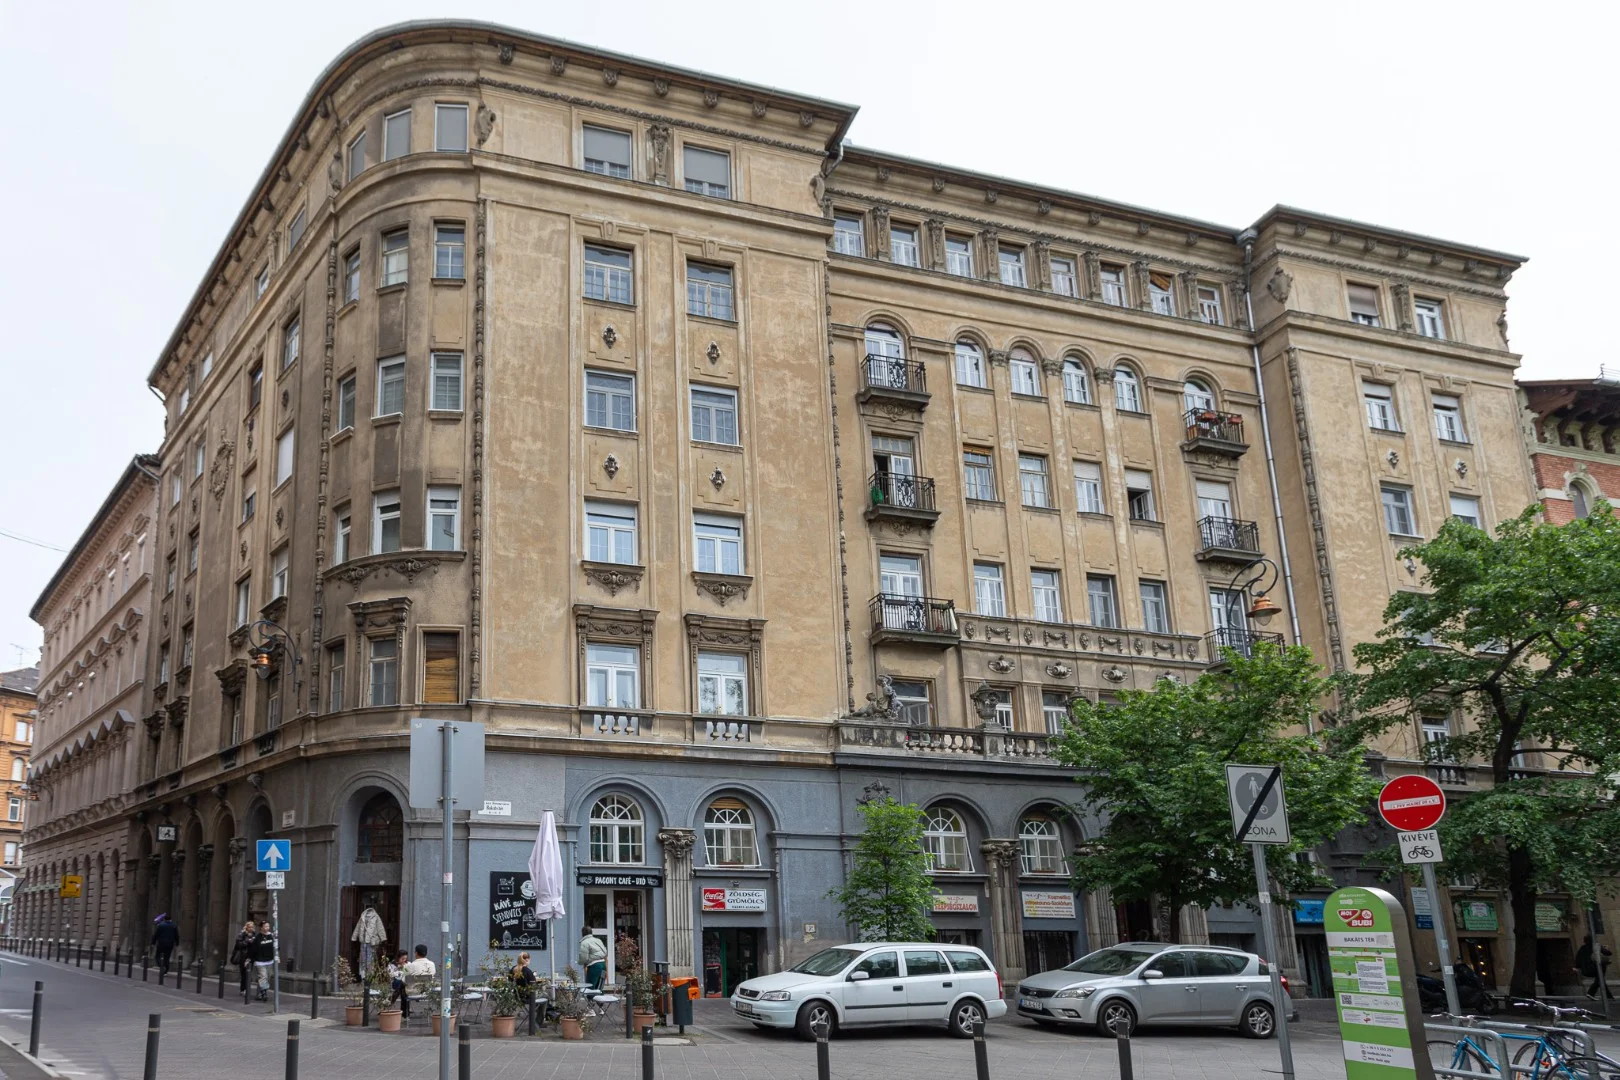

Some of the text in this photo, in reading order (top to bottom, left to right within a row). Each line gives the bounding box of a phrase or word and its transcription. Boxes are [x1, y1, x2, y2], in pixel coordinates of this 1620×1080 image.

[1400, 831, 1436, 843] KIVÉVE
[704, 891, 725, 900] Coca-Cola
[493, 898, 511, 911] KÁVÉ
[1351, 919, 1373, 927] BUBI
